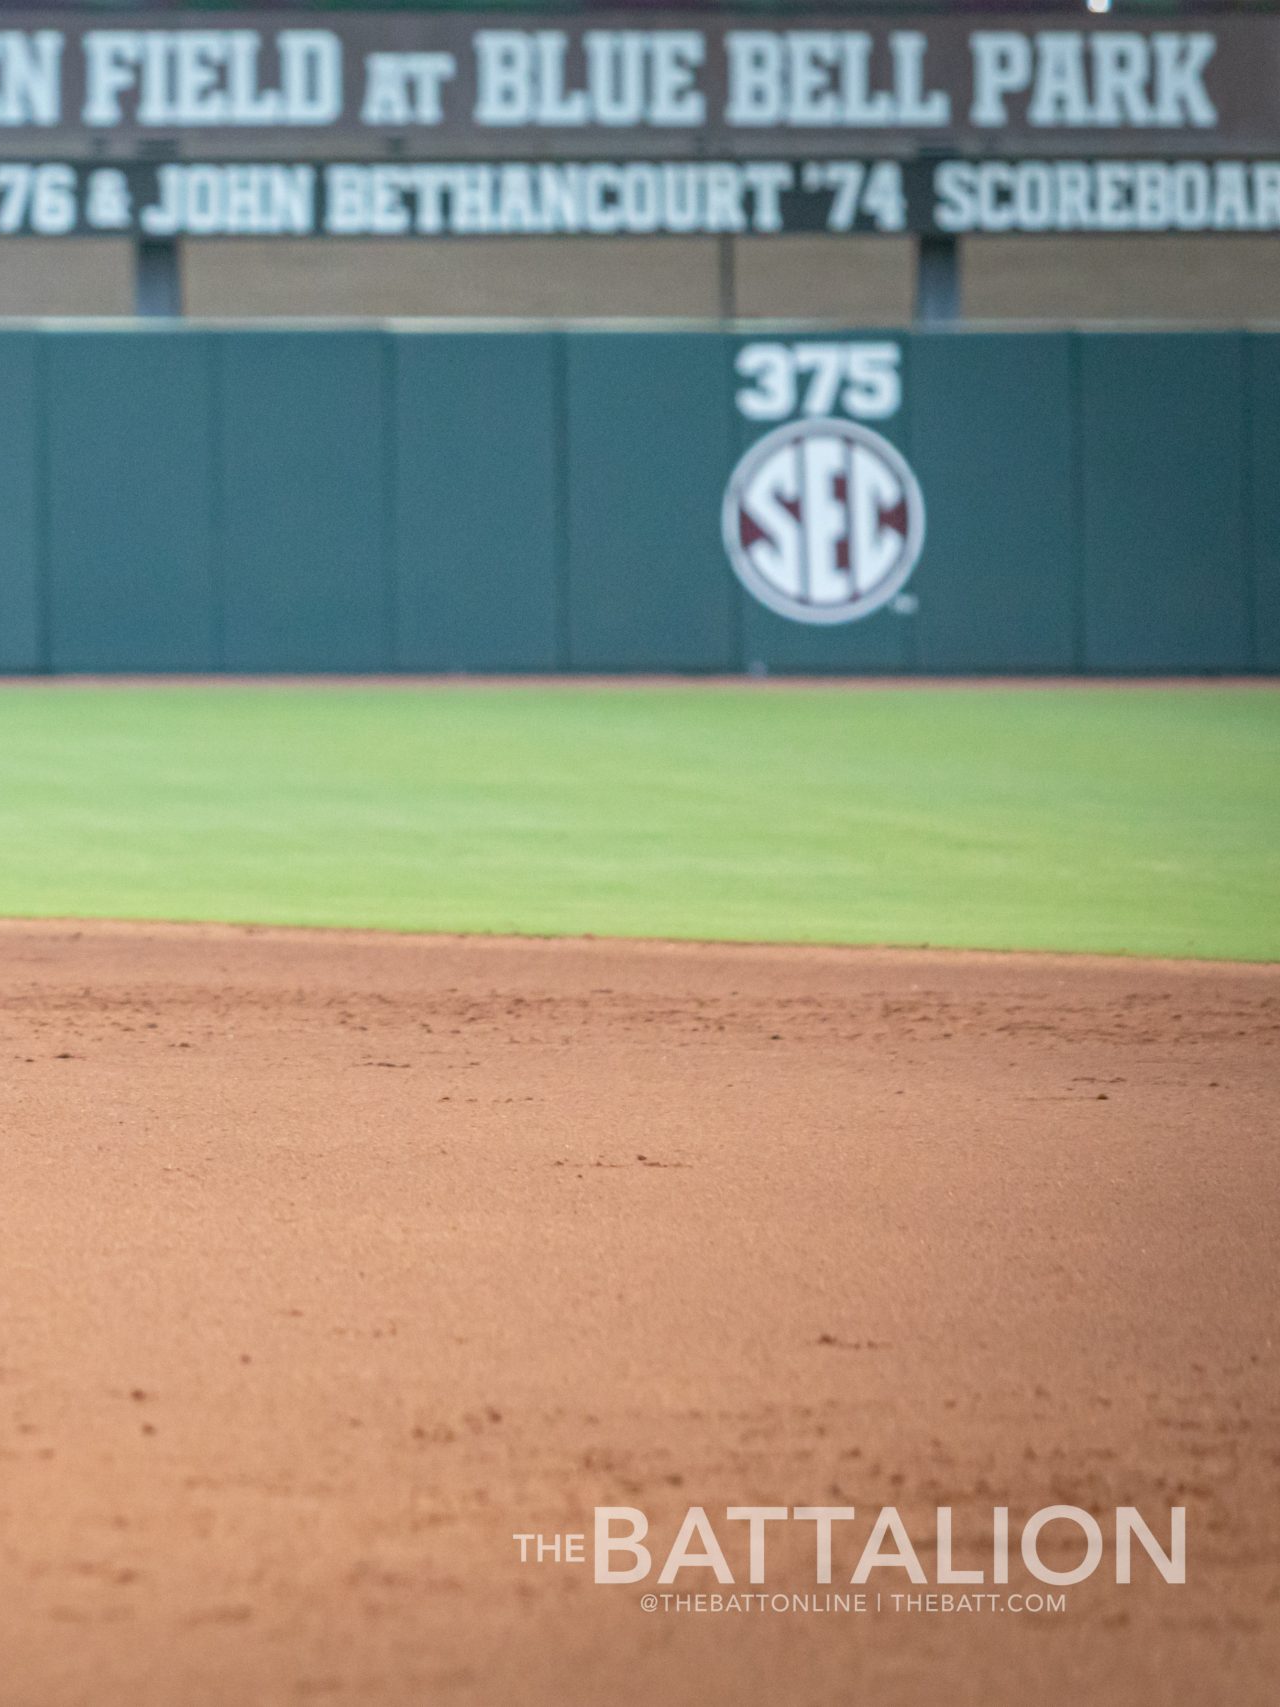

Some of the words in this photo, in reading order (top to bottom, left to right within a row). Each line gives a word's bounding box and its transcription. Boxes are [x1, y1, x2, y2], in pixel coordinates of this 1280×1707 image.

[82, 31, 341, 126] FIELD
[361, 52, 455, 126] AT
[474, 31, 705, 126] BLUE
[725, 31, 949, 126] BELL
[970, 32, 1216, 127] PARK
[86, 168, 131, 229] &
[141, 164, 313, 234] JOHN
[326, 163, 791, 233] BETHANCOURT
[735, 342, 902, 419] 375
[742, 437, 903, 605] SEC
